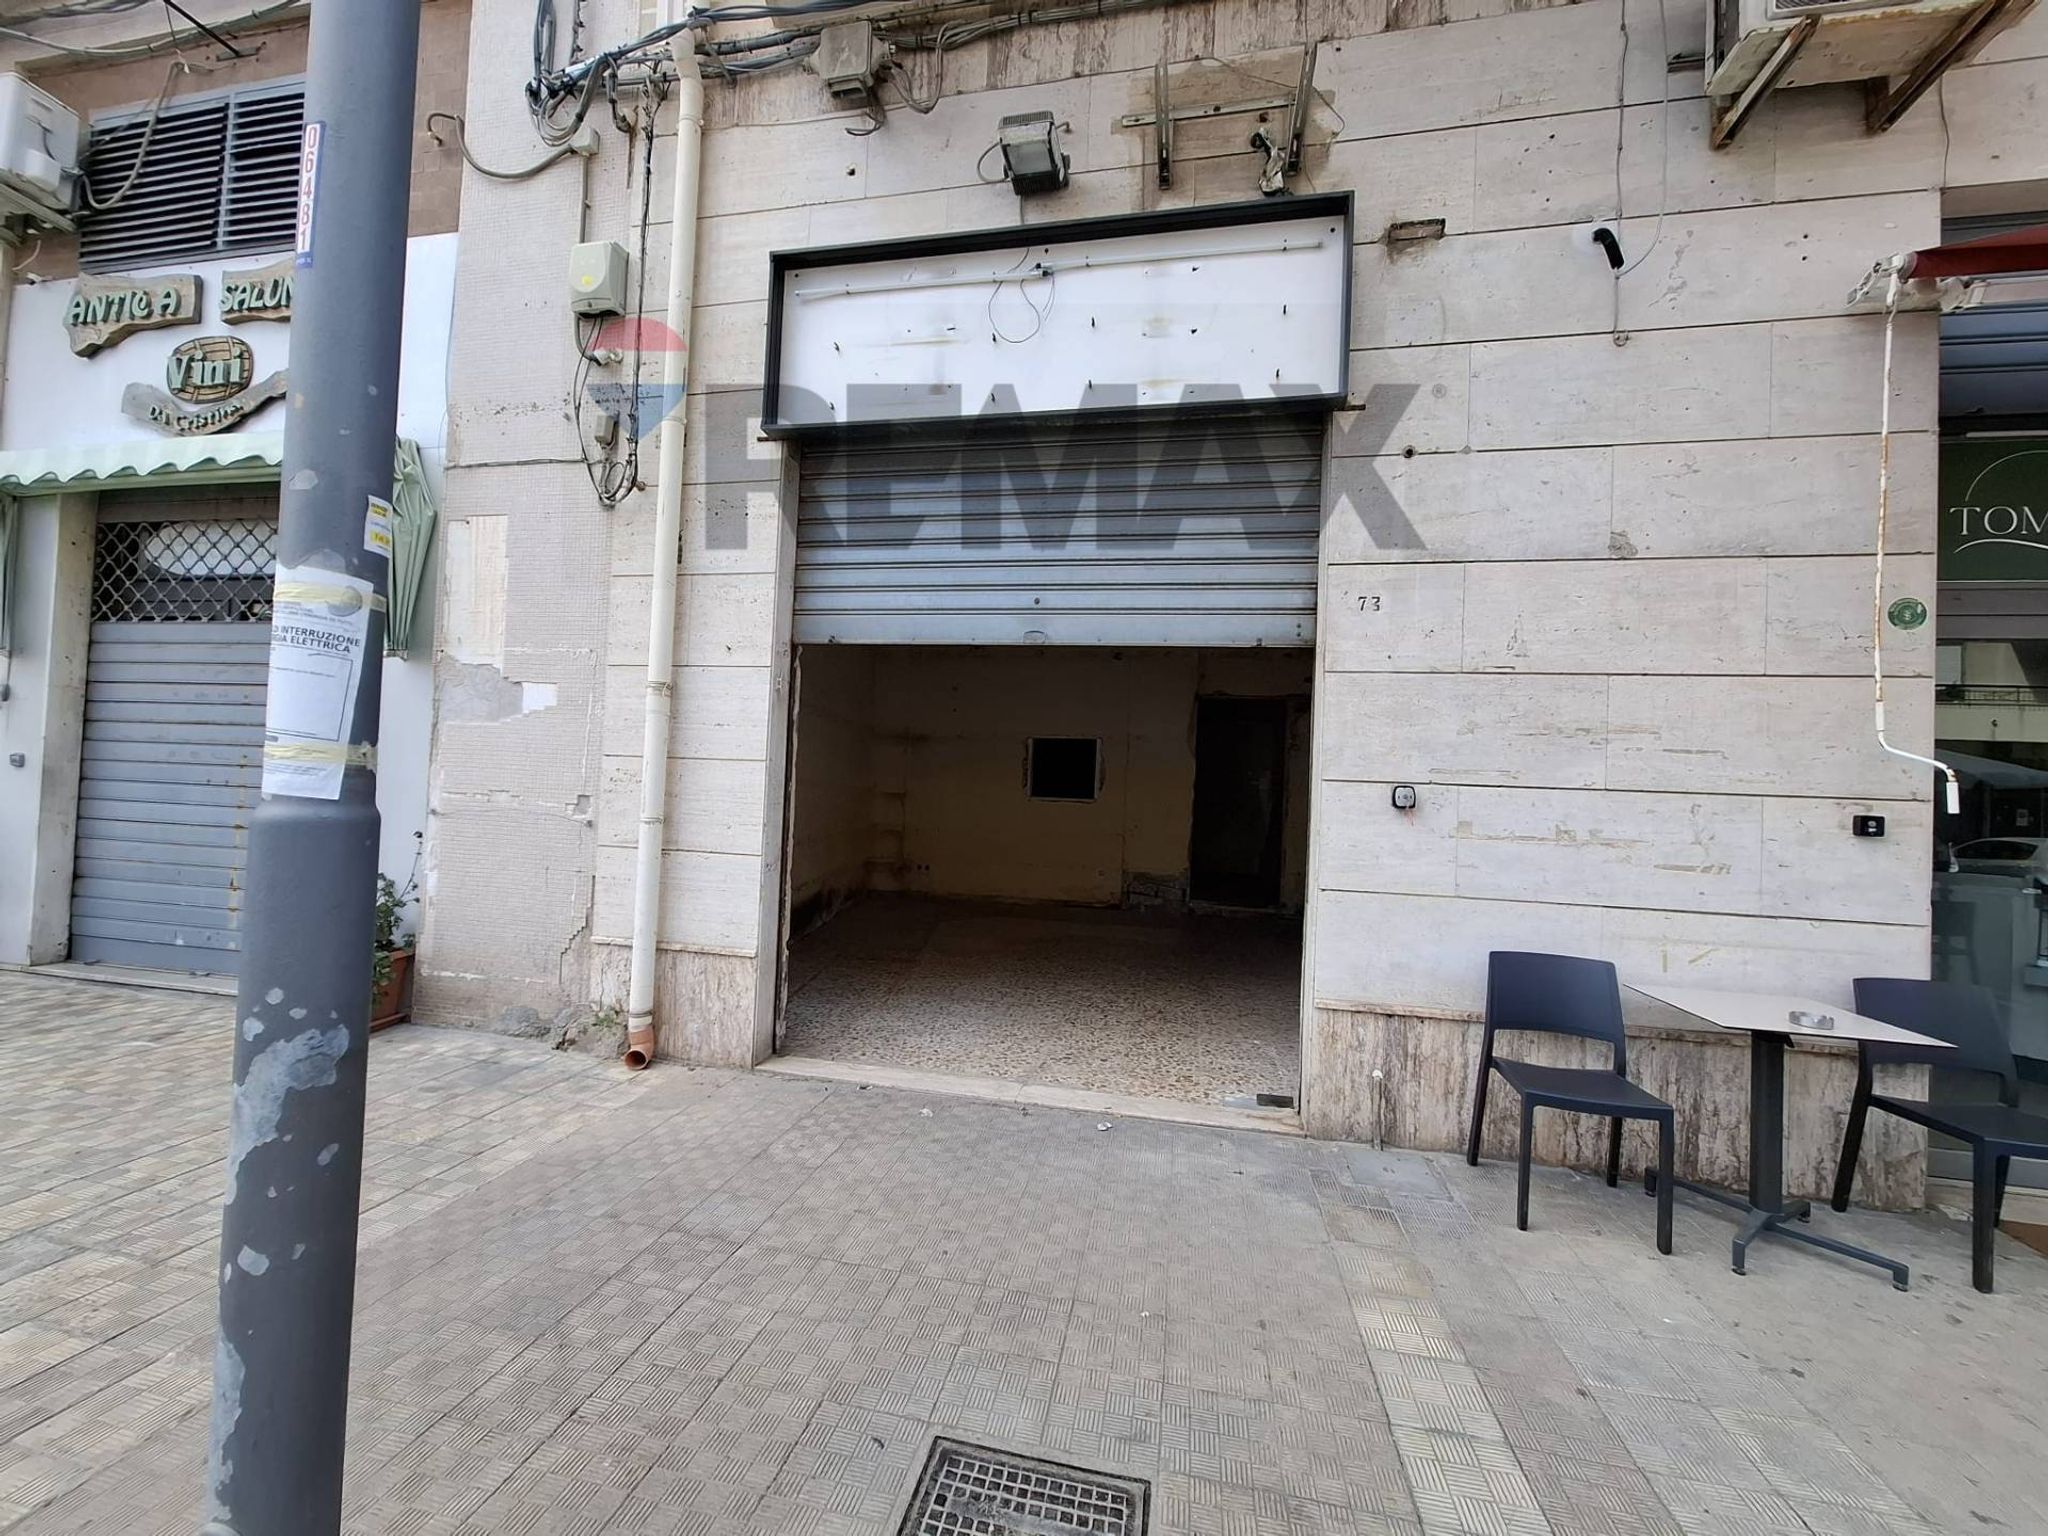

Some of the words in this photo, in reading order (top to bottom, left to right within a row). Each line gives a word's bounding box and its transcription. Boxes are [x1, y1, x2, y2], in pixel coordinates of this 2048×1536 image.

[300, 126, 317, 250] 06481
[66, 287, 180, 325] ANTICA
[167, 347, 243, 390] Vini
[1358, 595, 1381, 612] 73
[281, 624, 361, 648] INTERRUZIONE
[290, 635, 352, 655] ELETTRICA
